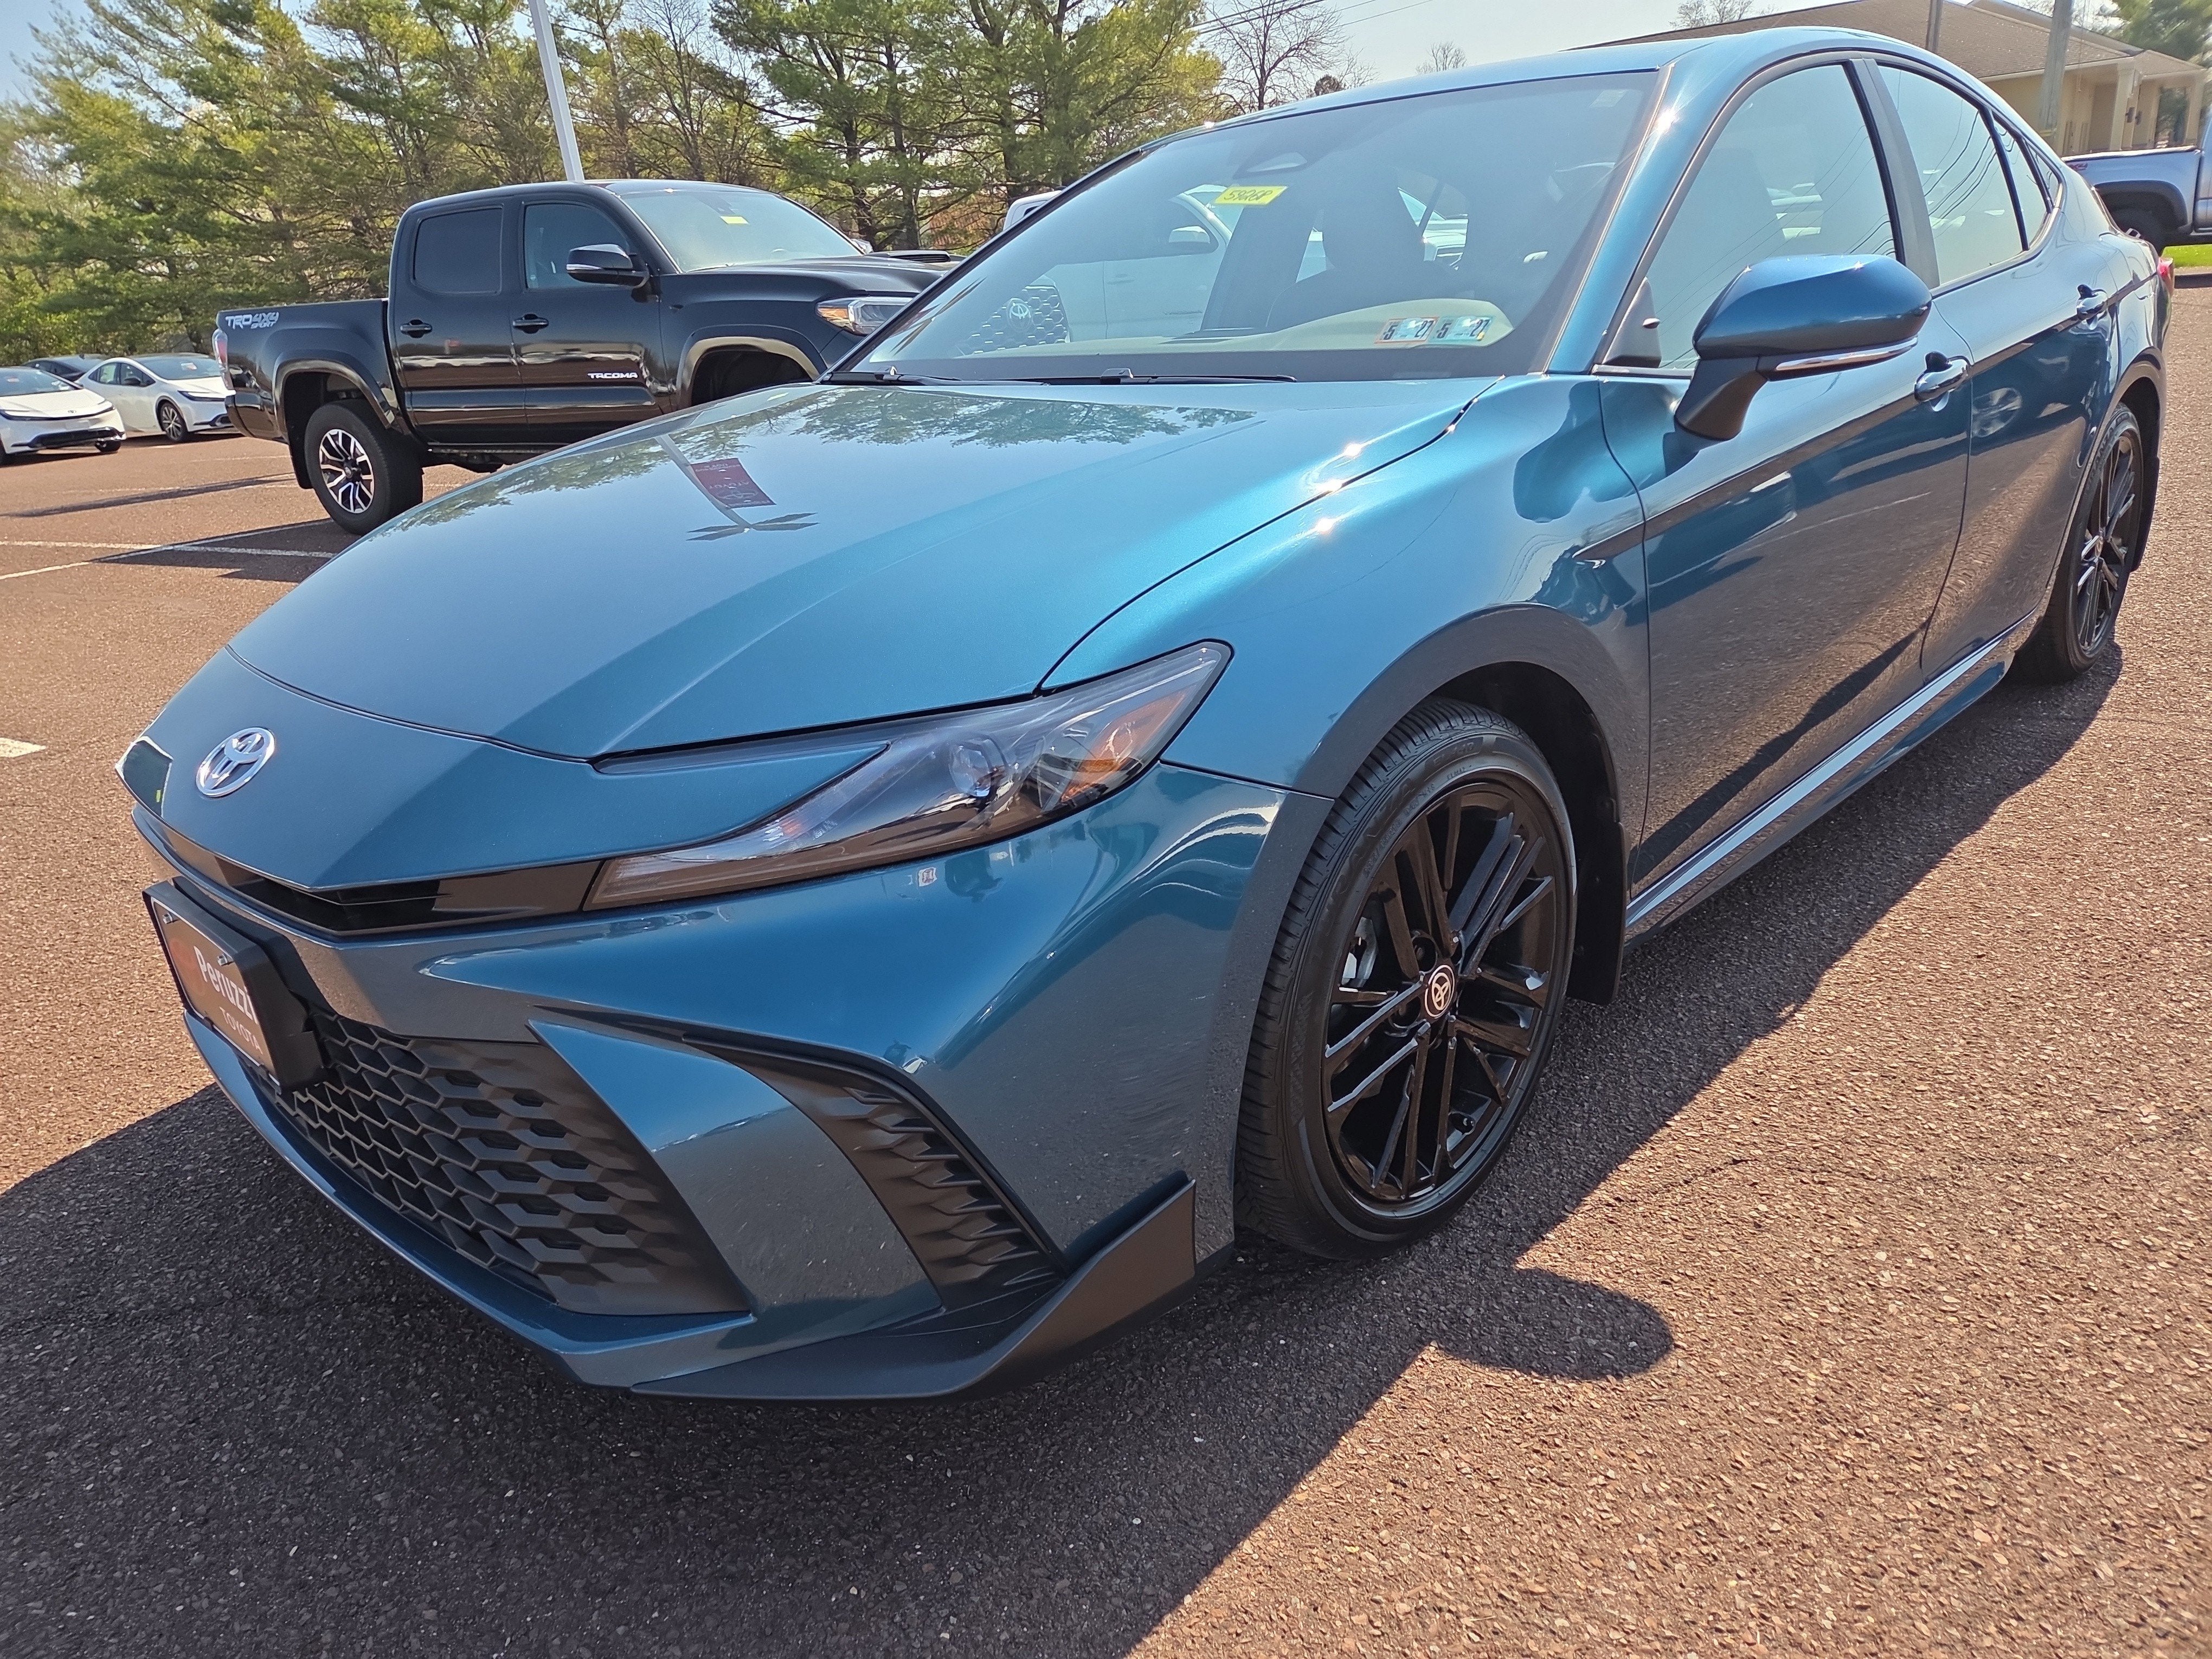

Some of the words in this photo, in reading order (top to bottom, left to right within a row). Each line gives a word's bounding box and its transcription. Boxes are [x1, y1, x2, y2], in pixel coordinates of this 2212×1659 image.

[1383, 325, 1399, 340] 5
[1436, 323, 1452, 339] 5
[194, 945, 258, 1024] Peruzzi
[219, 1006, 263, 1054] TOYOTA
